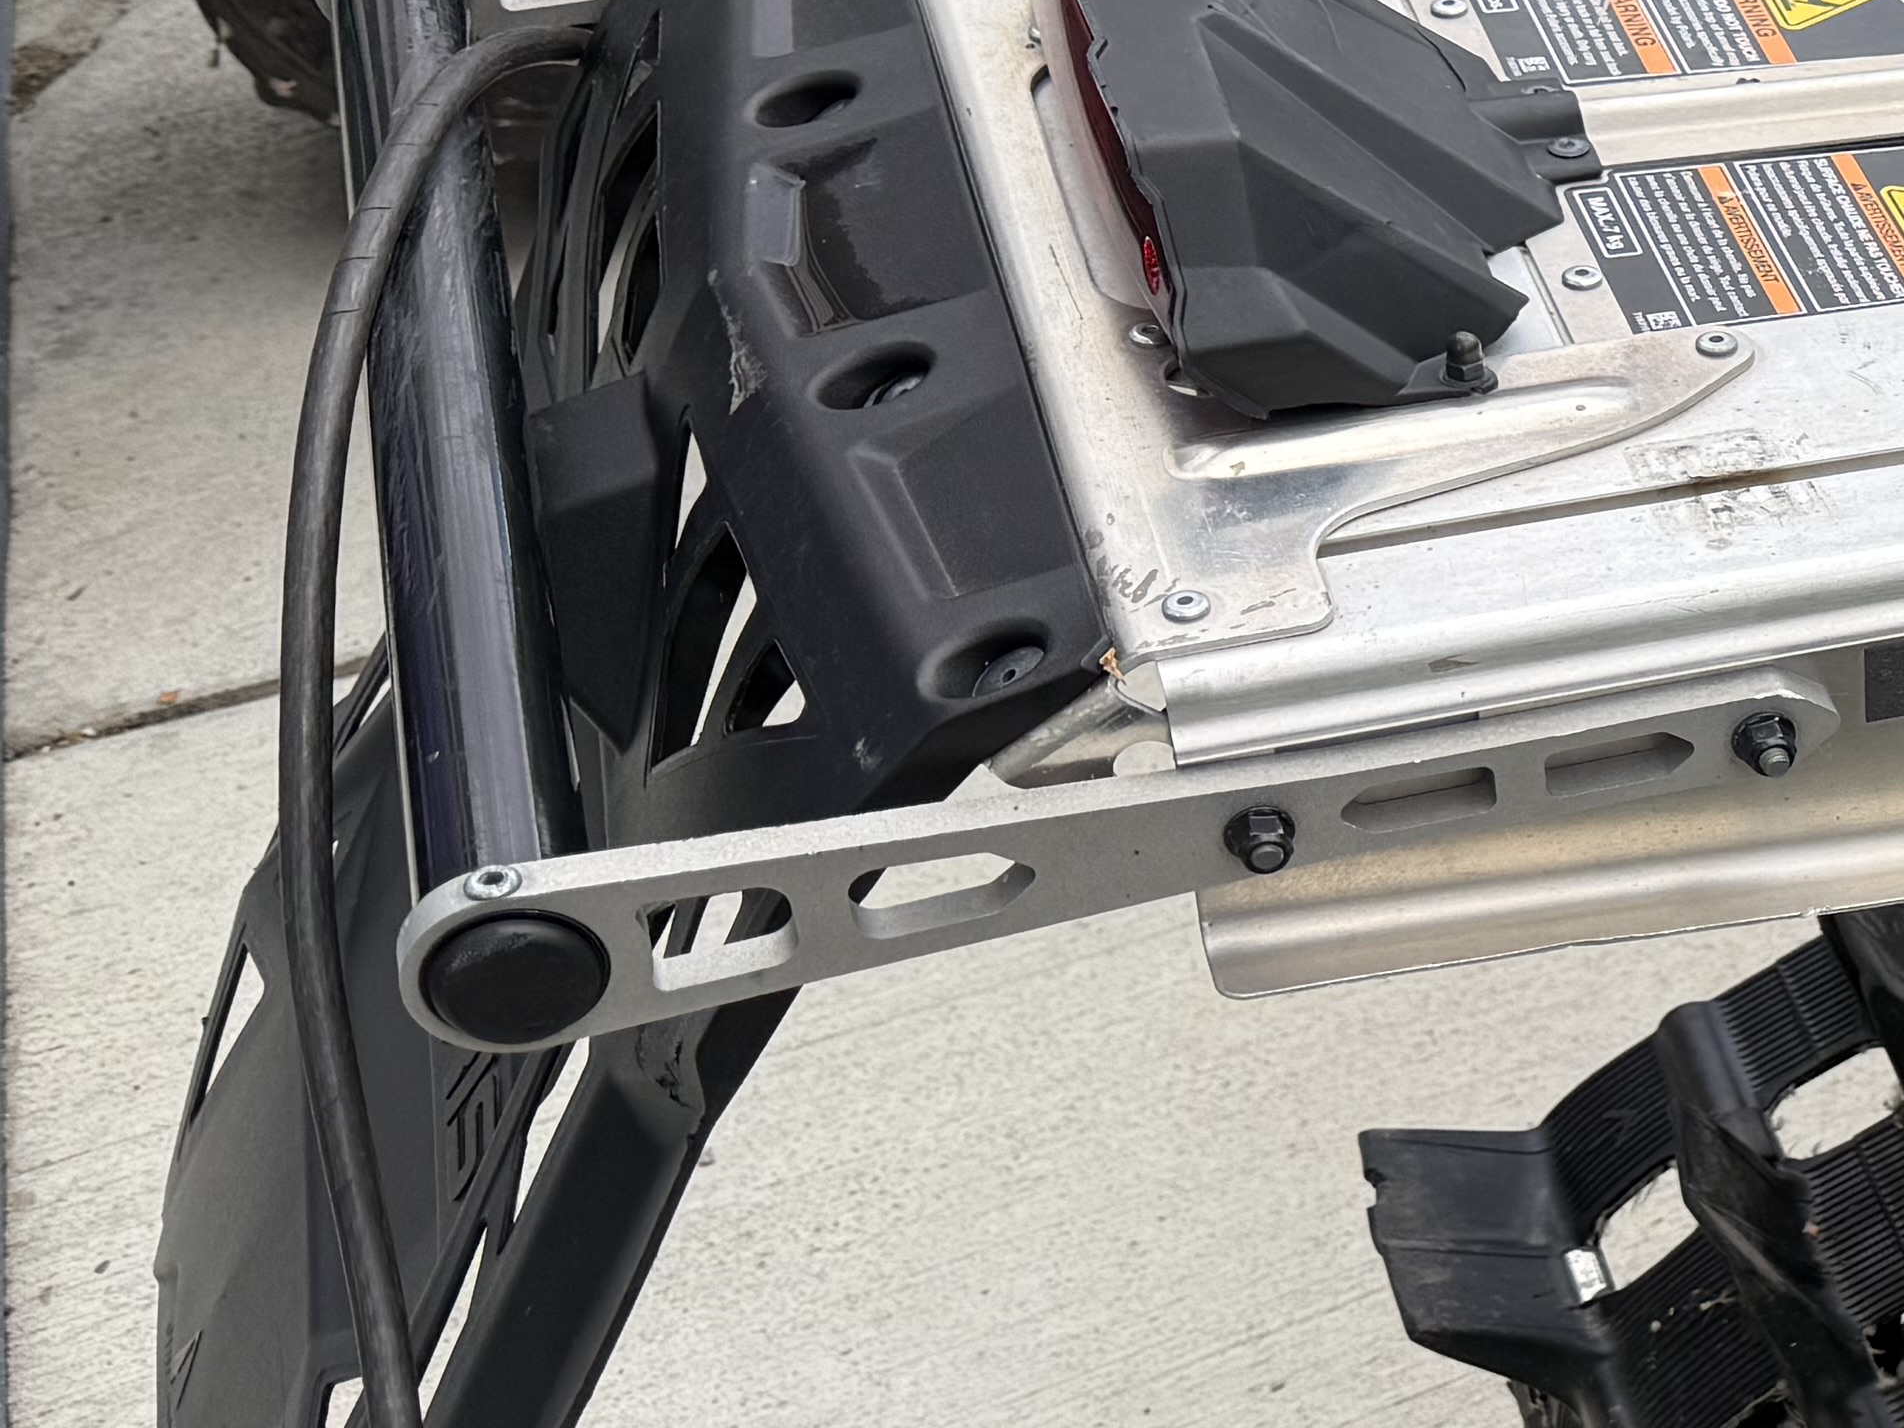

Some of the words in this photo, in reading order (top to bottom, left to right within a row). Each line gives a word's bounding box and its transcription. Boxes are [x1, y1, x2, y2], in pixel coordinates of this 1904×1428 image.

[1720, 12, 1743, 30] NOT
[1731, 31, 1760, 62] TOUCH
[1812, 157, 1847, 195] SURFACE
[1834, 194, 1867, 229] CHAUDE
[1599, 223, 1621, 233] 7
[1854, 228, 1874, 241] NE
[1603, 234, 1630, 250] kg
[1721, 204, 1779, 284] AVERTISSEMENT
[1862, 240, 1884, 259] PAS
